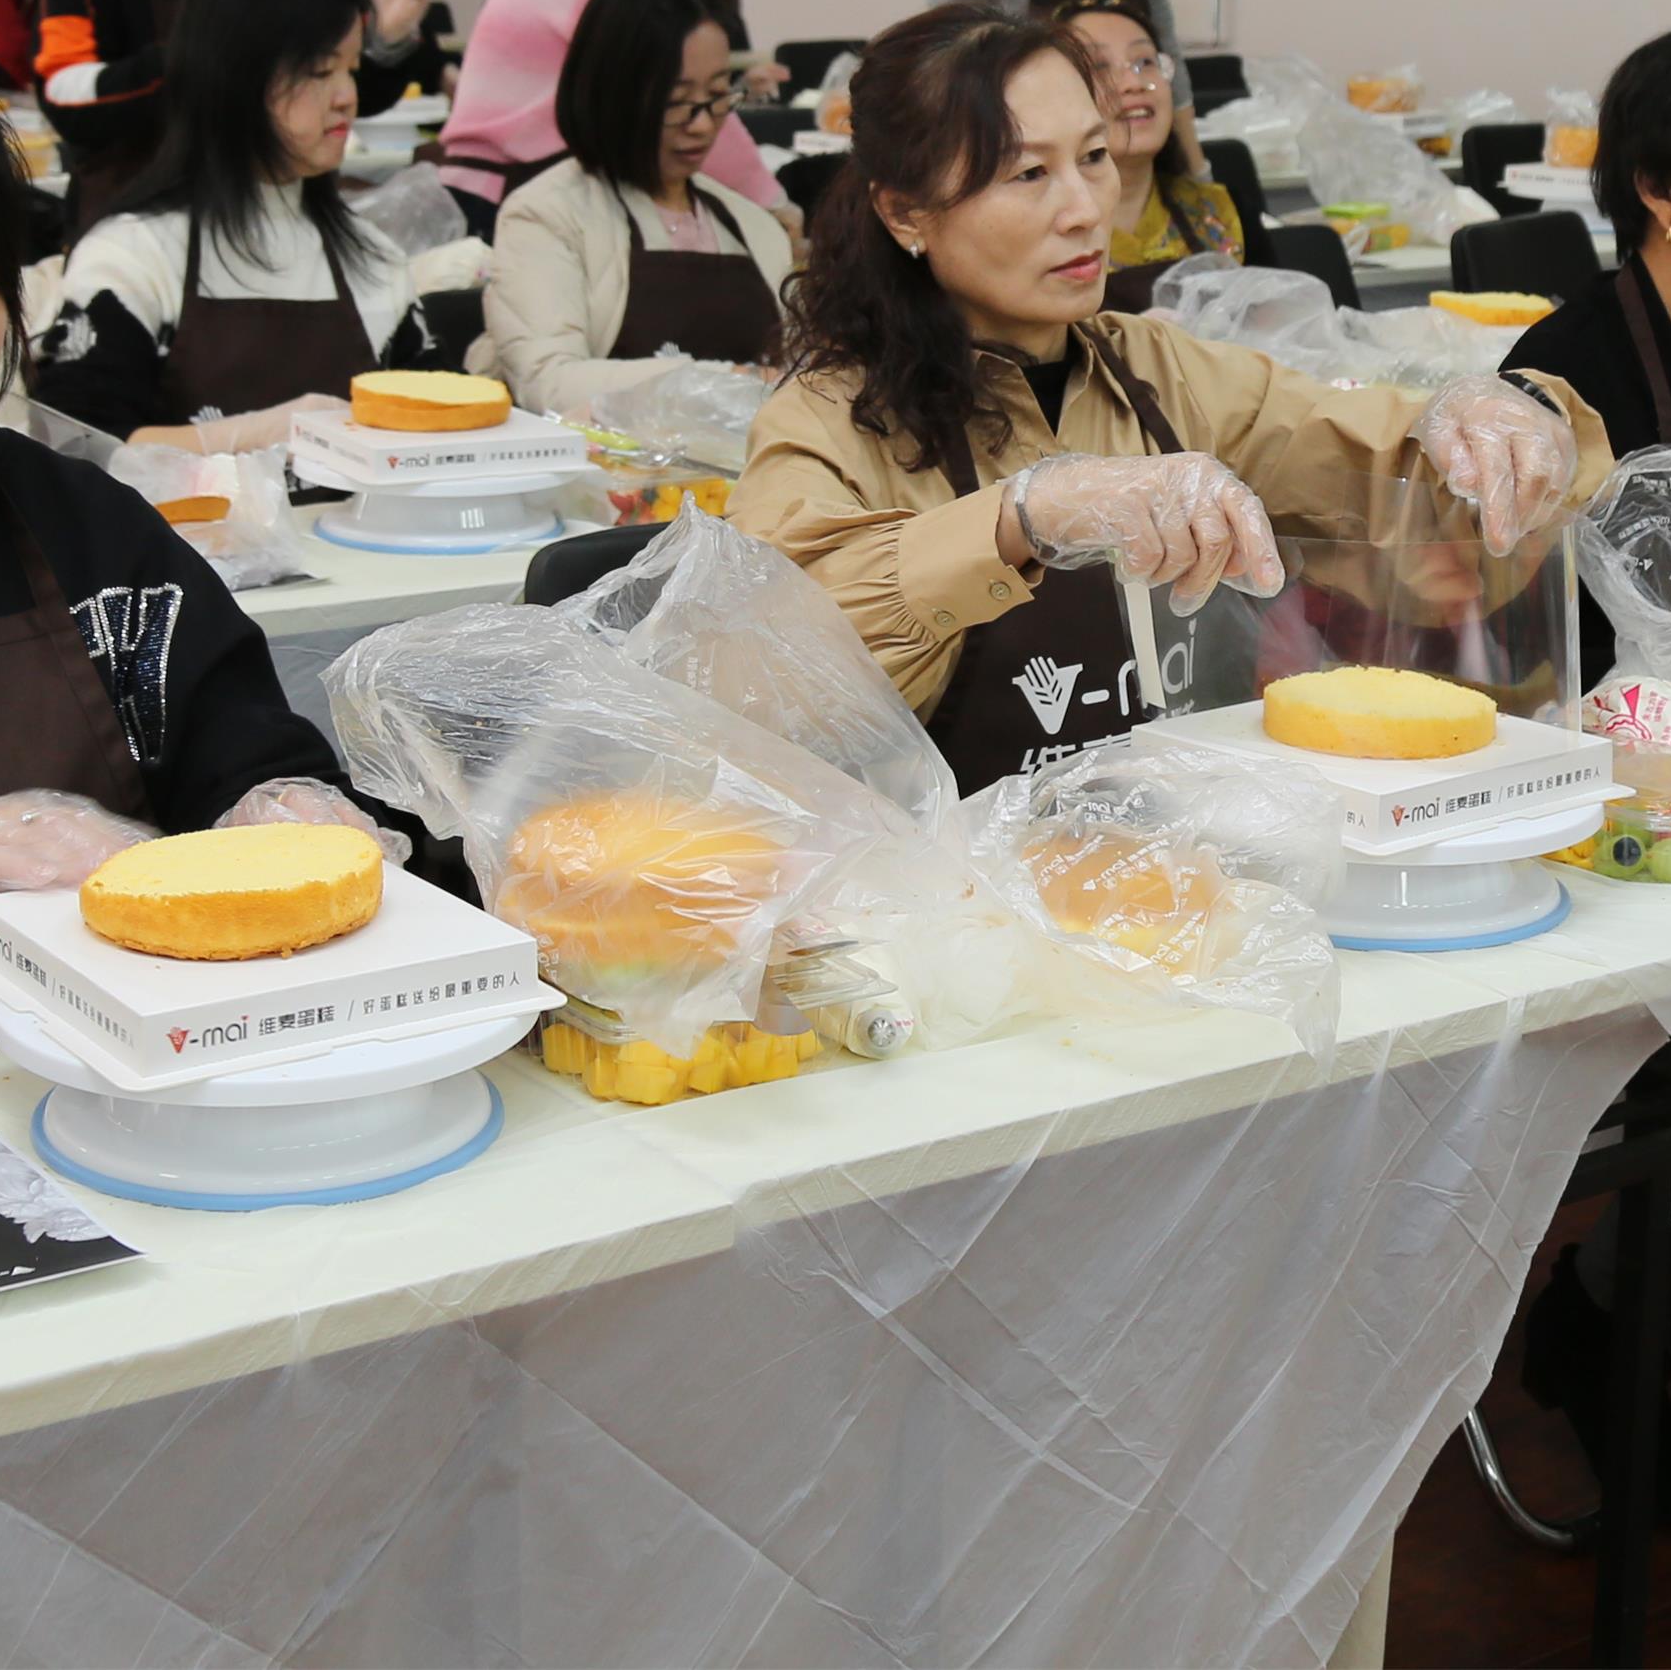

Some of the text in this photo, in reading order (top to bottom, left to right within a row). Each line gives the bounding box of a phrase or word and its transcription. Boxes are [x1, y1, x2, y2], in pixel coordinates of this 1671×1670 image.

[1391, 797, 1440, 827] V-mai
[1445, 790, 1491, 814] 维麦蛋糕
[166, 1015, 249, 1054] V-mai
[259, 1005, 335, 1036] 维麦蛋糕
[363, 971, 521, 1015] 好蛋糕送给最重要的人
